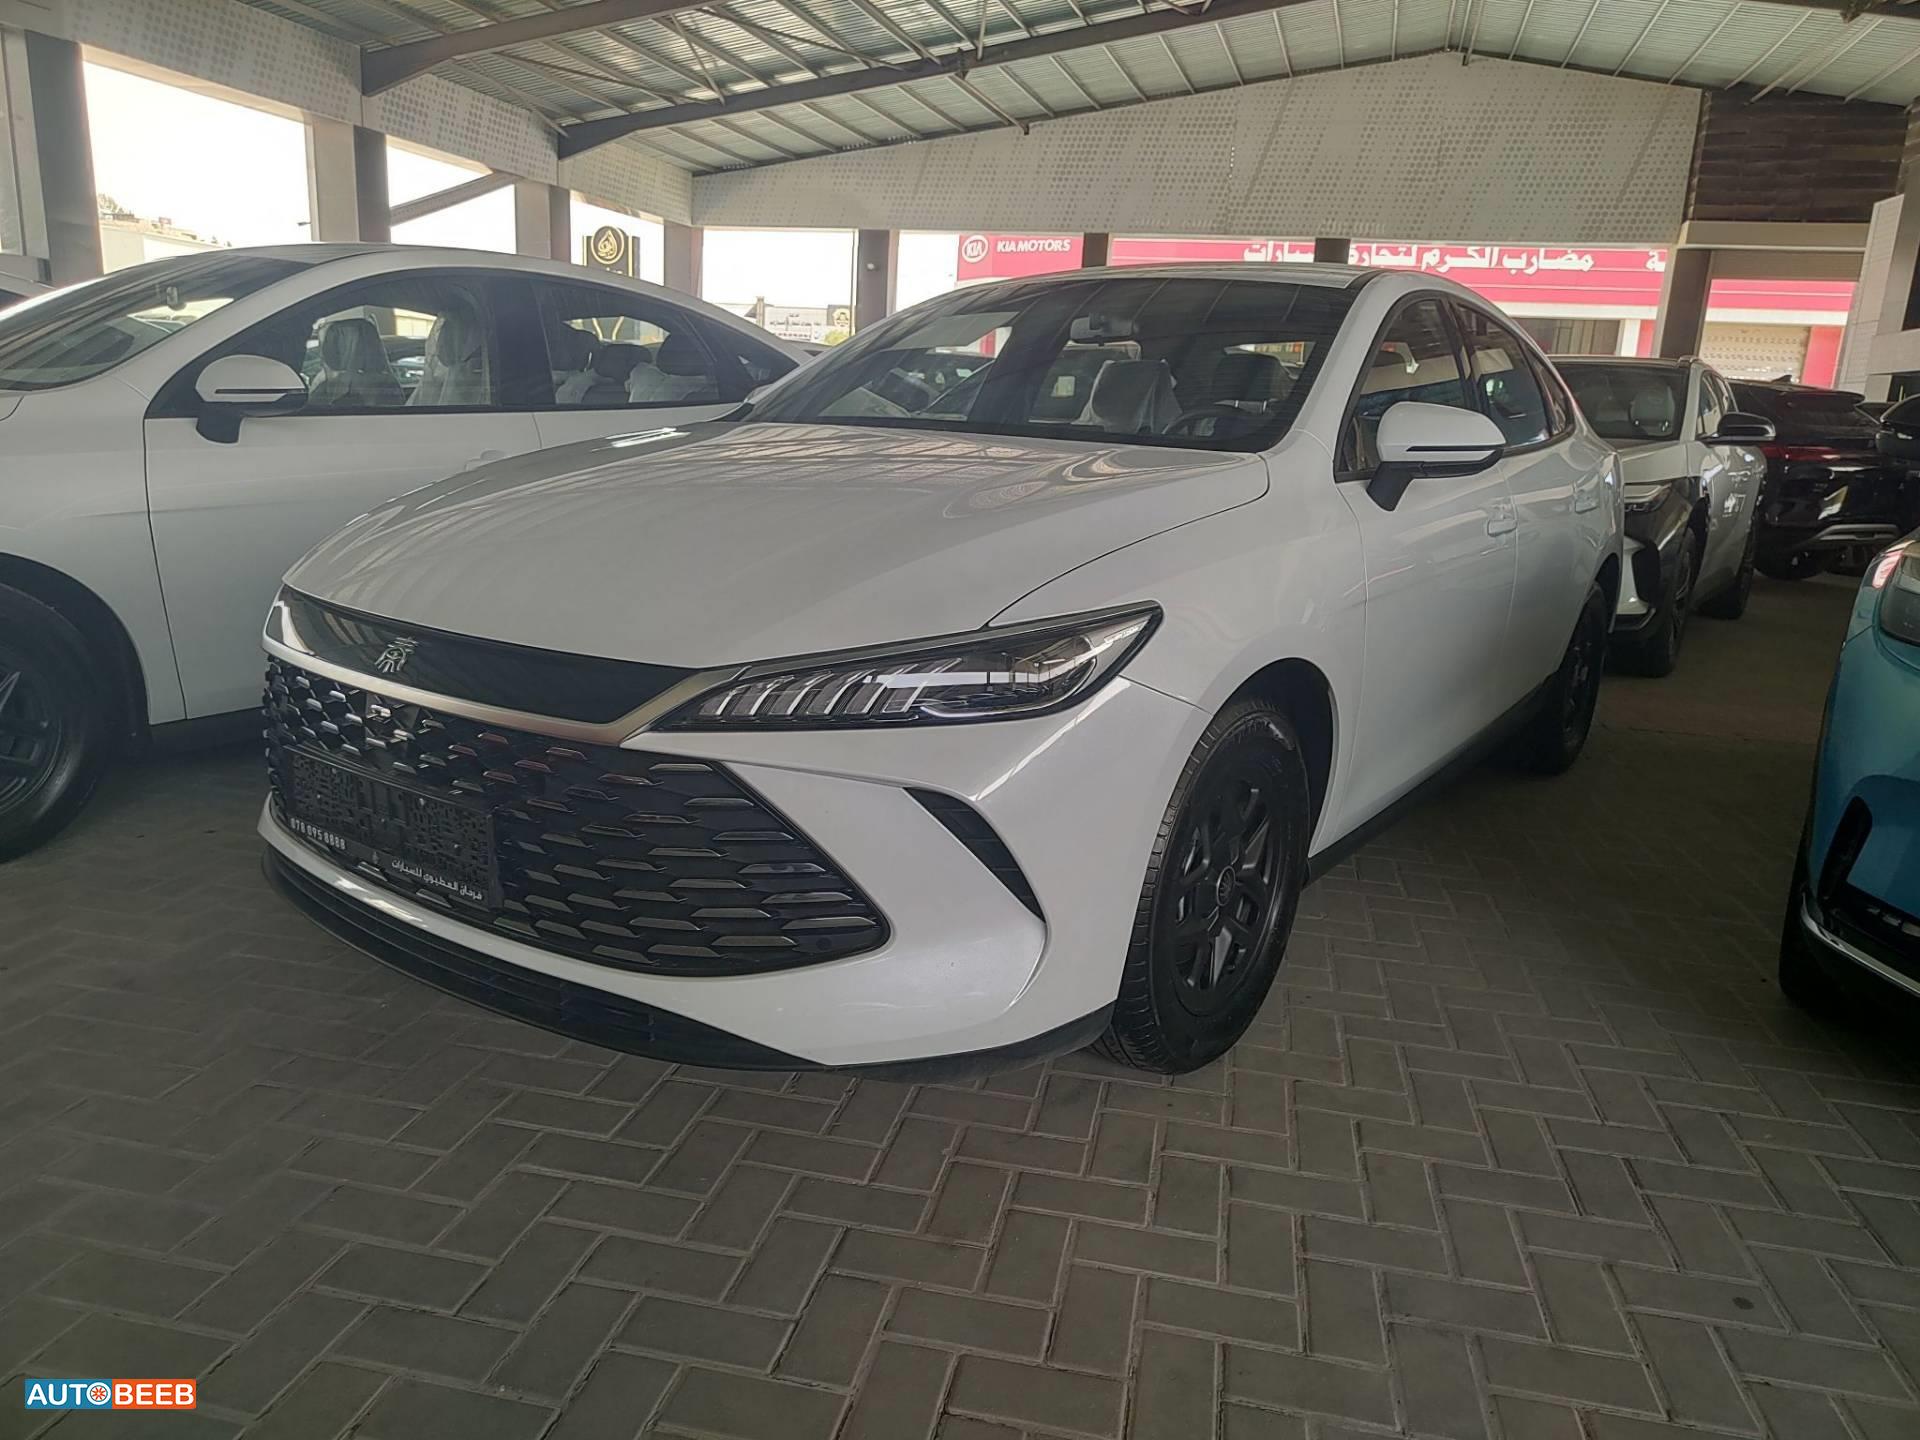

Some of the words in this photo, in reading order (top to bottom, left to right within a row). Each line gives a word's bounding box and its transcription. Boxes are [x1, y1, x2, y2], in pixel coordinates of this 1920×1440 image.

[966, 241, 982, 257] KIA
[1347, 243, 1417, 268] لتجارة
[1420, 246, 1500, 273] الكرم
[1502, 247, 1595, 276] مضارب
